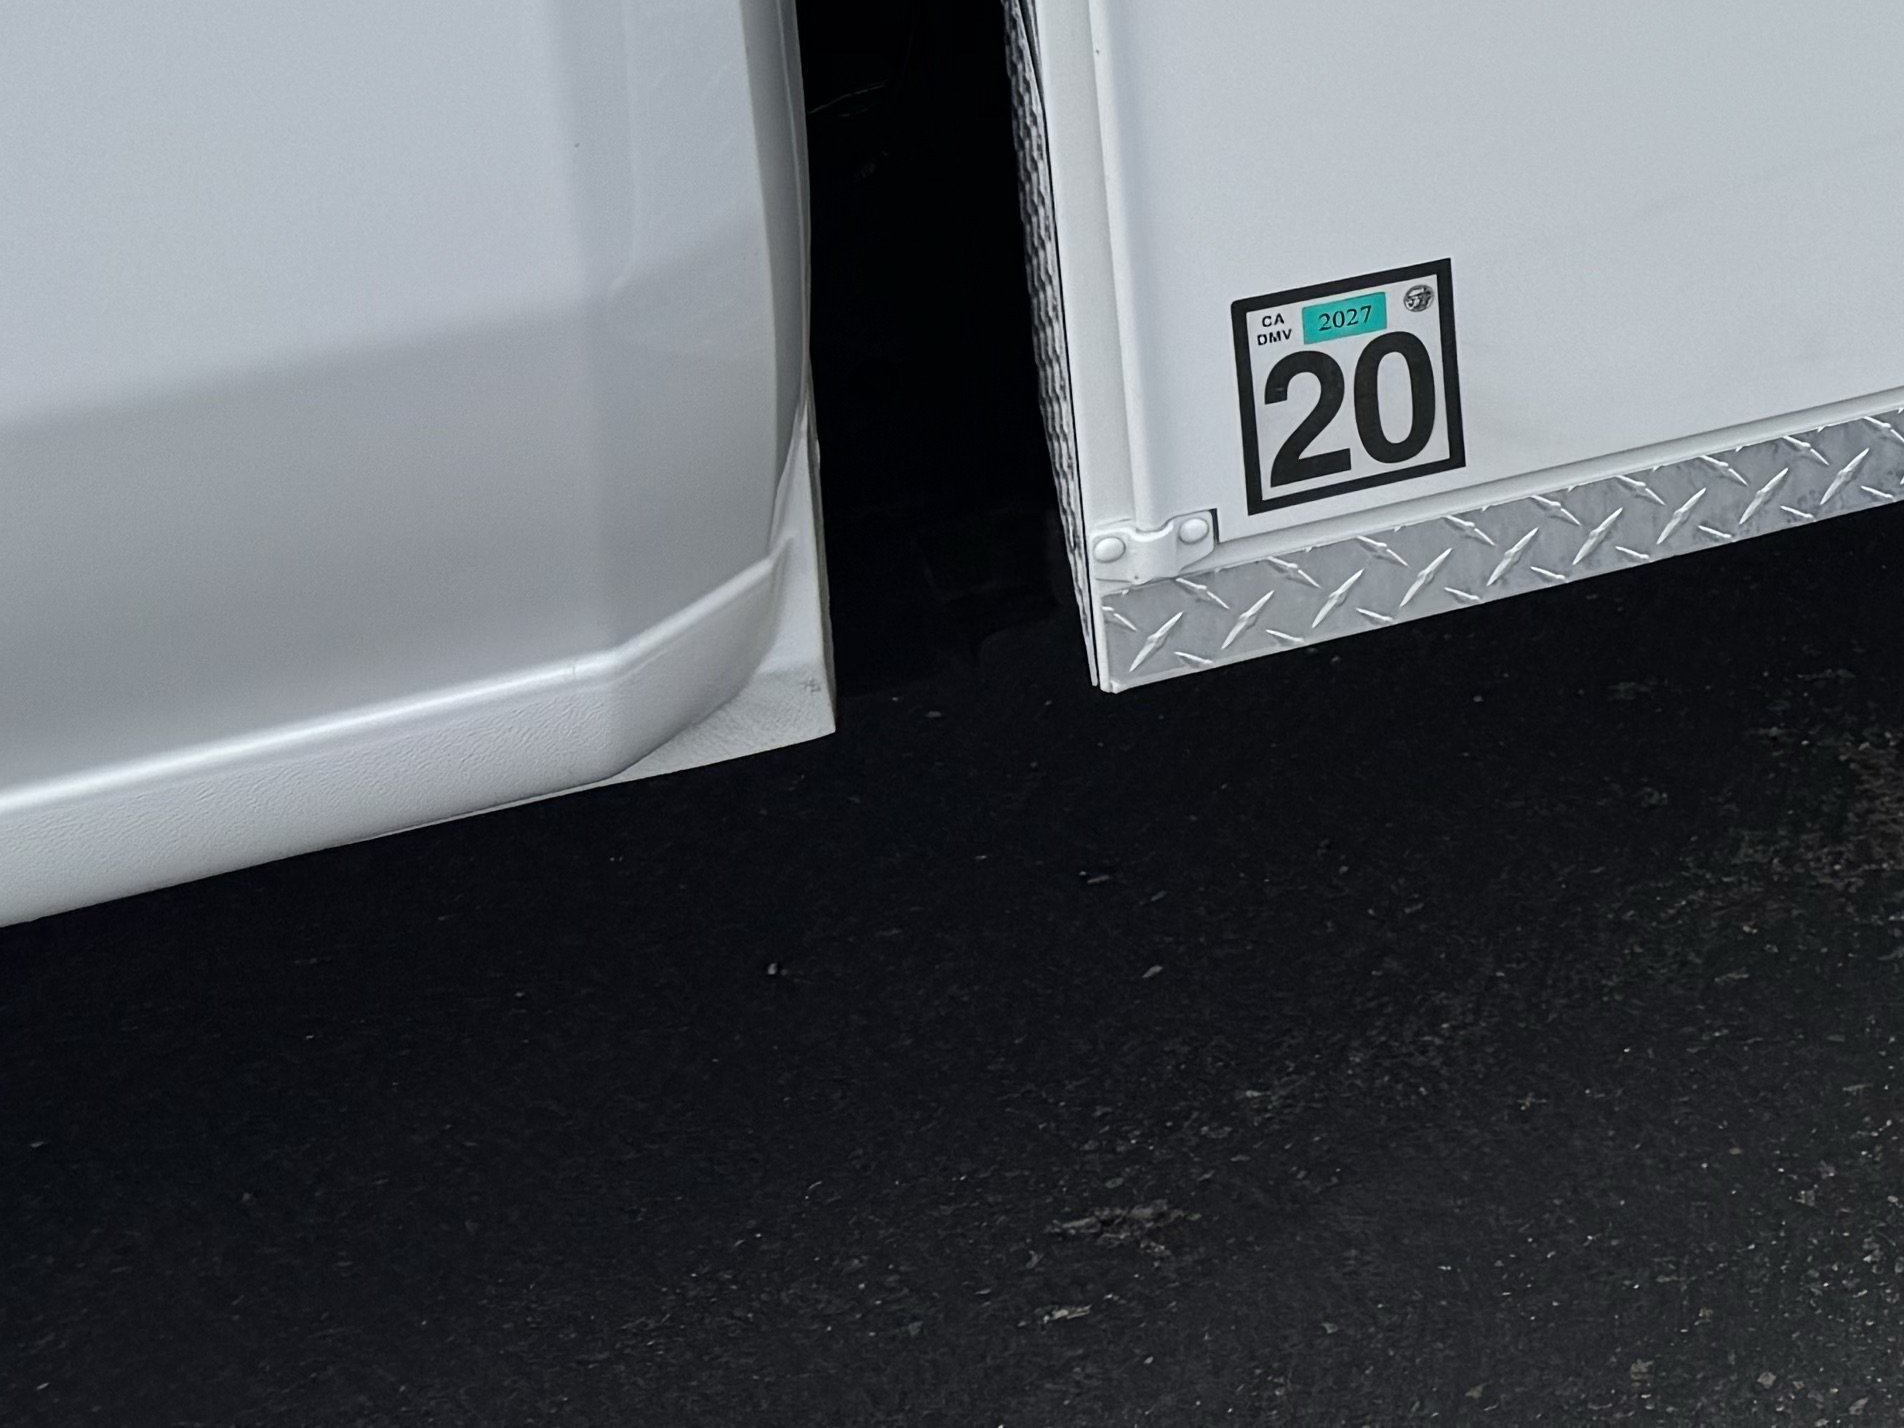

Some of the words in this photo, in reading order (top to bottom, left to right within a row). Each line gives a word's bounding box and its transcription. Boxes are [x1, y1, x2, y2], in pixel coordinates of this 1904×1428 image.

[1261, 312, 1286, 328] CA
[1317, 305, 1373, 332] 2027
[1256, 328, 1293, 346] DMV
[1264, 330, 1436, 488] 20
